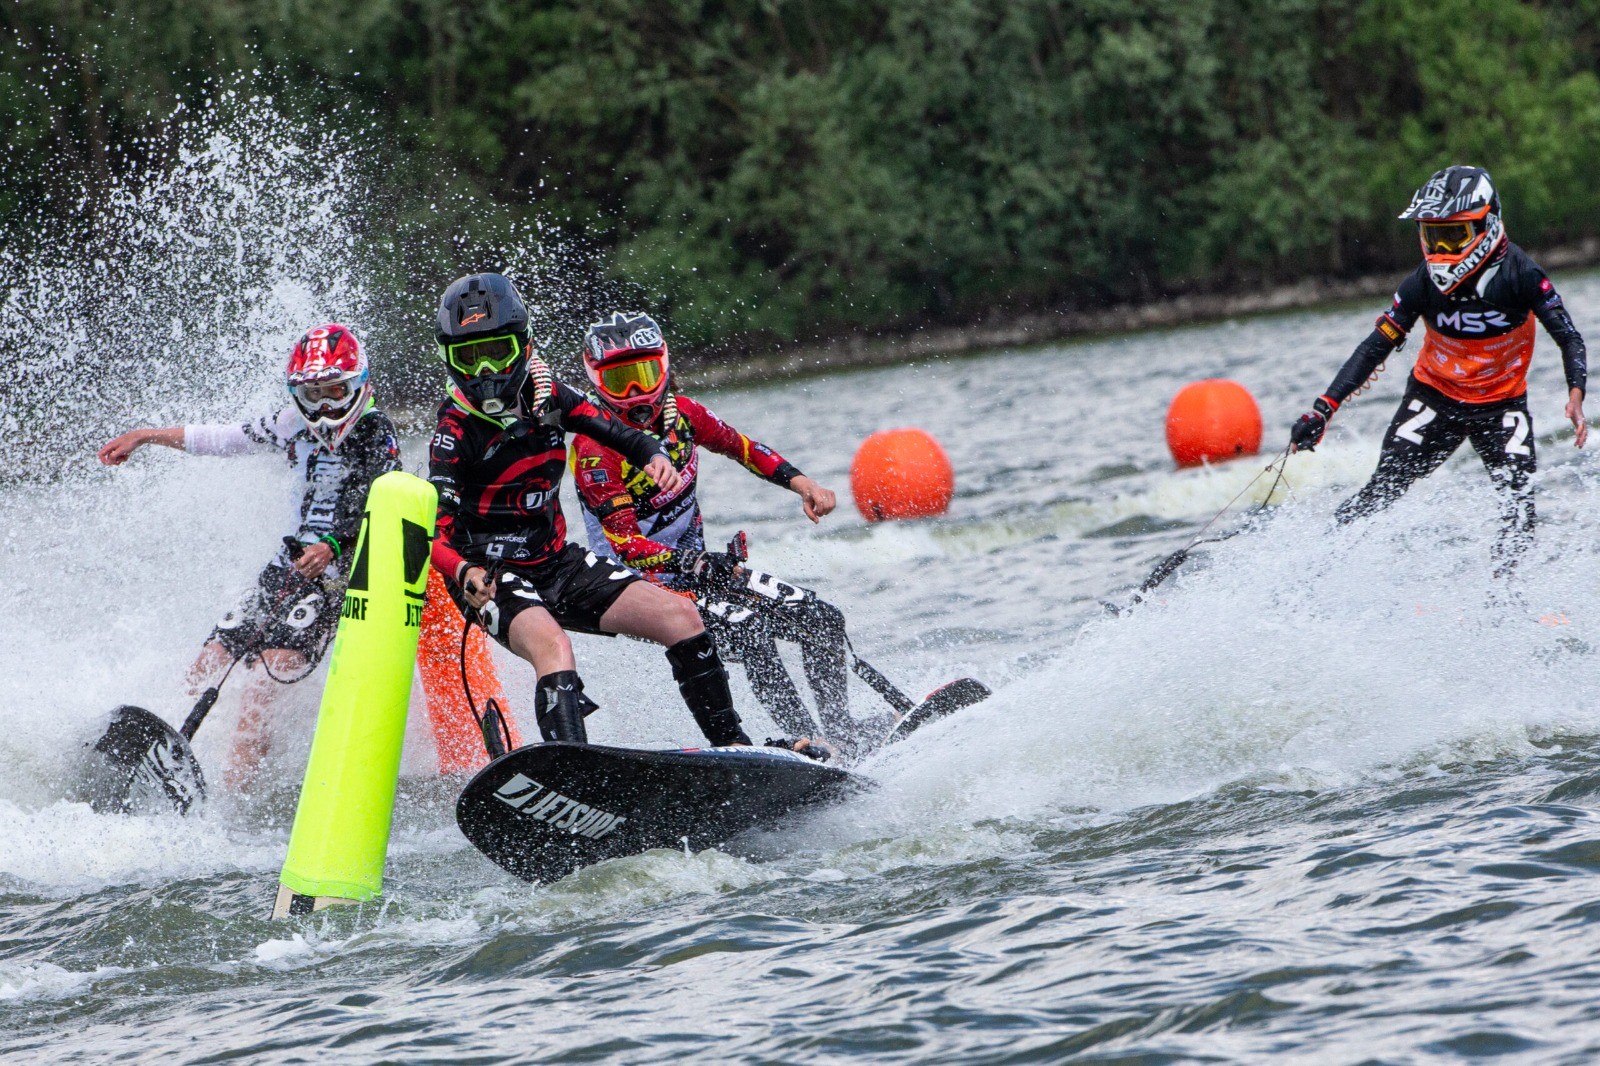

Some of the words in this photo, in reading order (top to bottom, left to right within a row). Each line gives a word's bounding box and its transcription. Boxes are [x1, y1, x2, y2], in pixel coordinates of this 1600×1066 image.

[1395, 398, 1438, 446] 2
[1502, 409, 1531, 457] 2
[433, 432, 456, 451] 35
[656, 490, 676, 506] the
[662, 491, 698, 522] MAGI
[494, 535, 528, 544] MOTOREX
[341, 595, 369, 621] URF
[404, 603, 423, 628] JET
[525, 788, 628, 841] JETSURF
